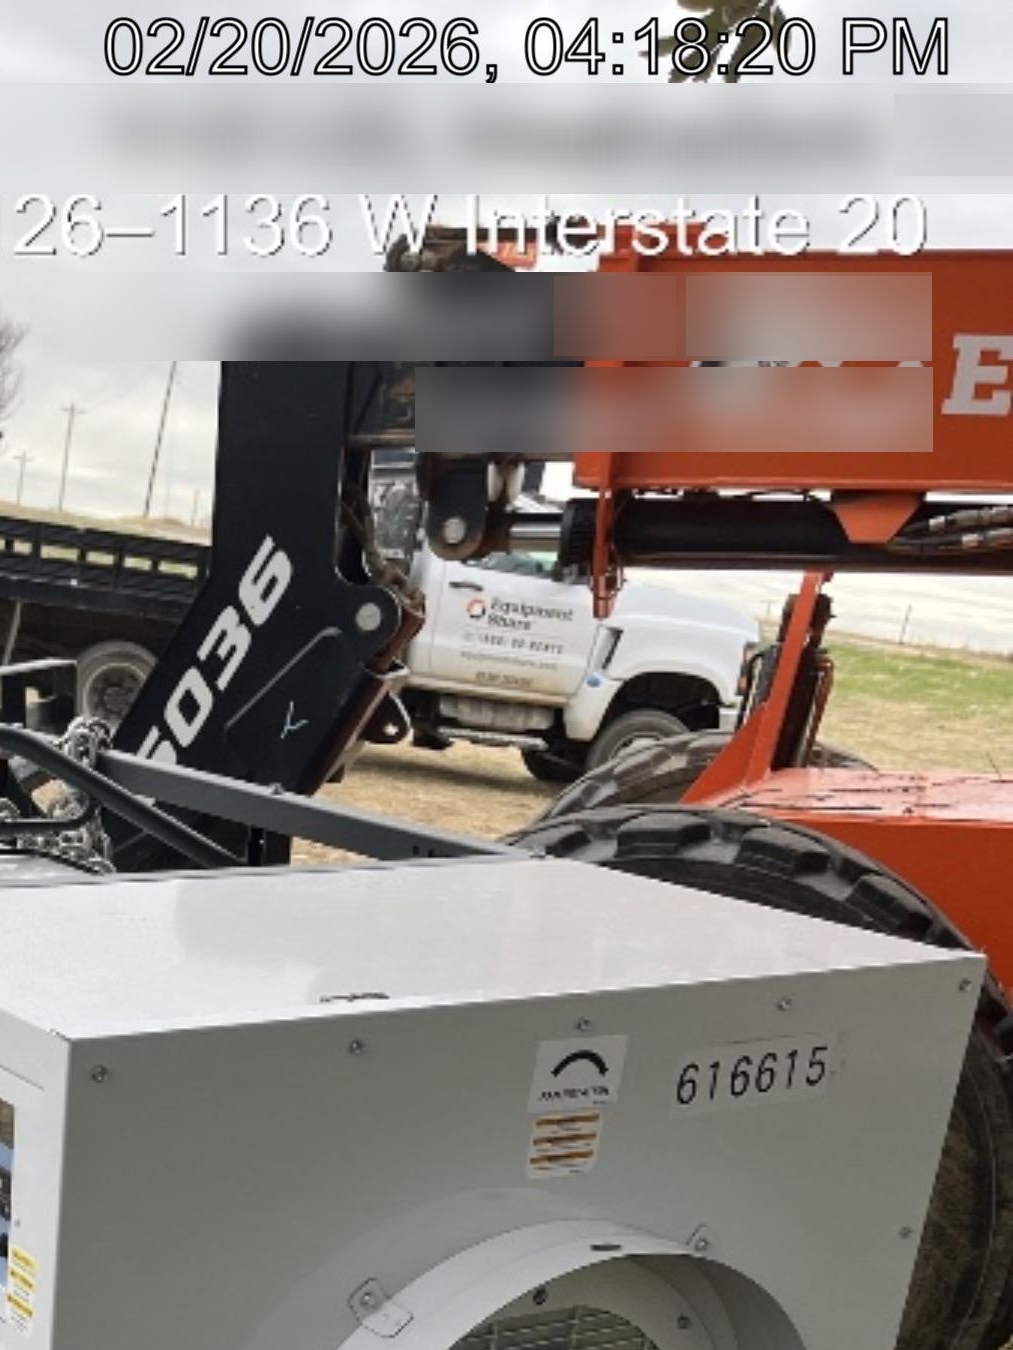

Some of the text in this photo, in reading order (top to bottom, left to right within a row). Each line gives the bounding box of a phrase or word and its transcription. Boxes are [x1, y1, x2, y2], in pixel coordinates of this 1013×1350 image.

[488, 612, 531, 632] Share
[490, 597, 573, 622] Equipment
[676, 1045, 829, 1105] 616615
